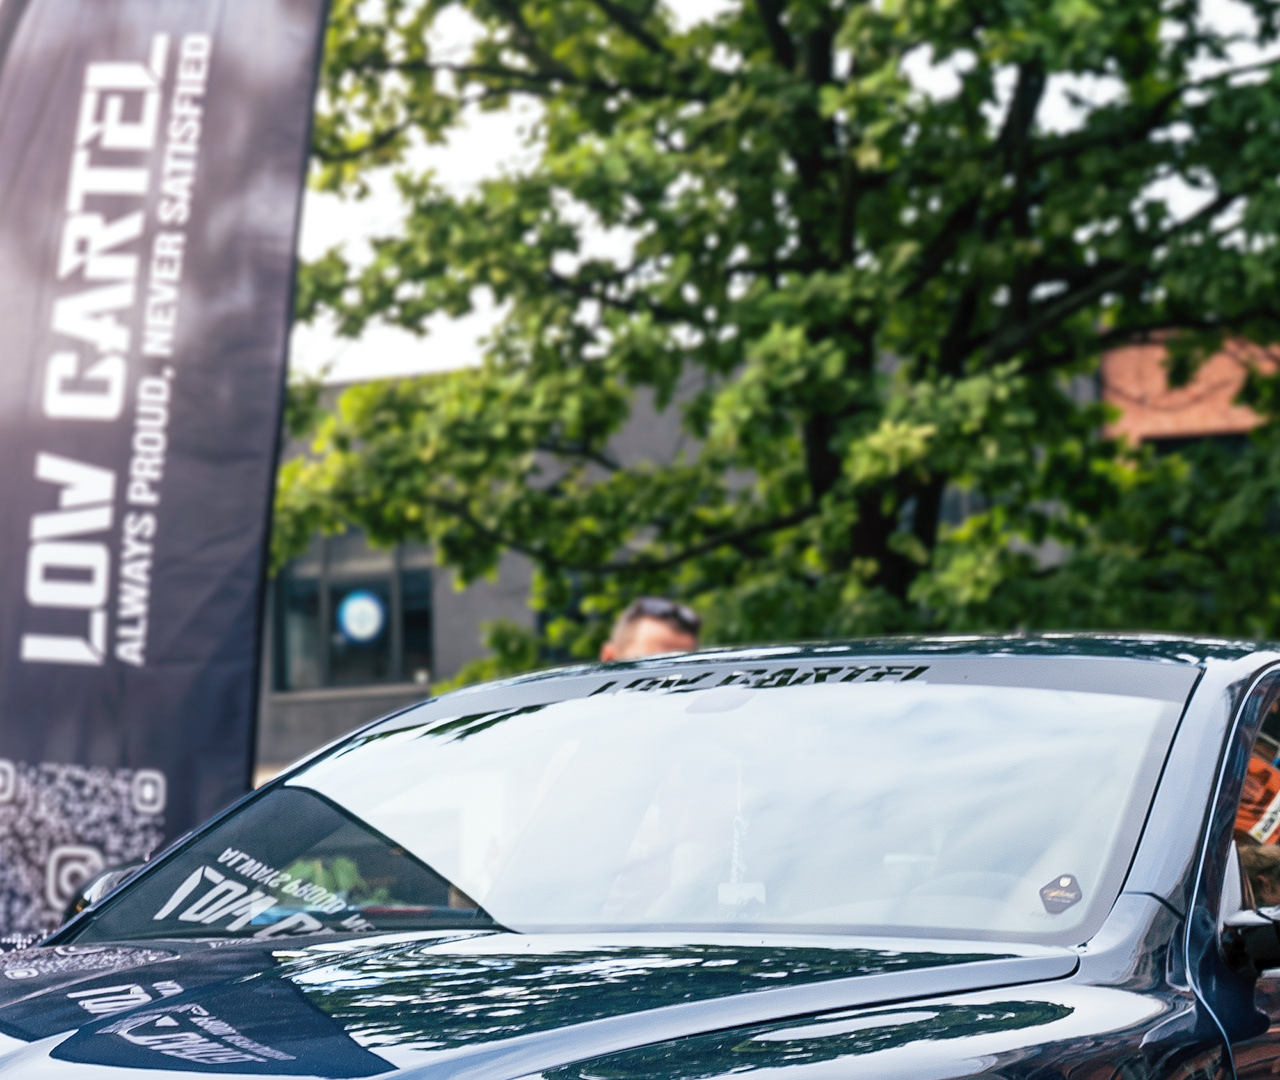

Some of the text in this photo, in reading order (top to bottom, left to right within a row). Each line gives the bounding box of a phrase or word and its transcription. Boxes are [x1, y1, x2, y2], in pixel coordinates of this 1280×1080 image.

[20, 32, 169, 666] LOW CARTEL
[115, 31, 212, 666] ALWAYS PROUD, NEVER SATISFIED
